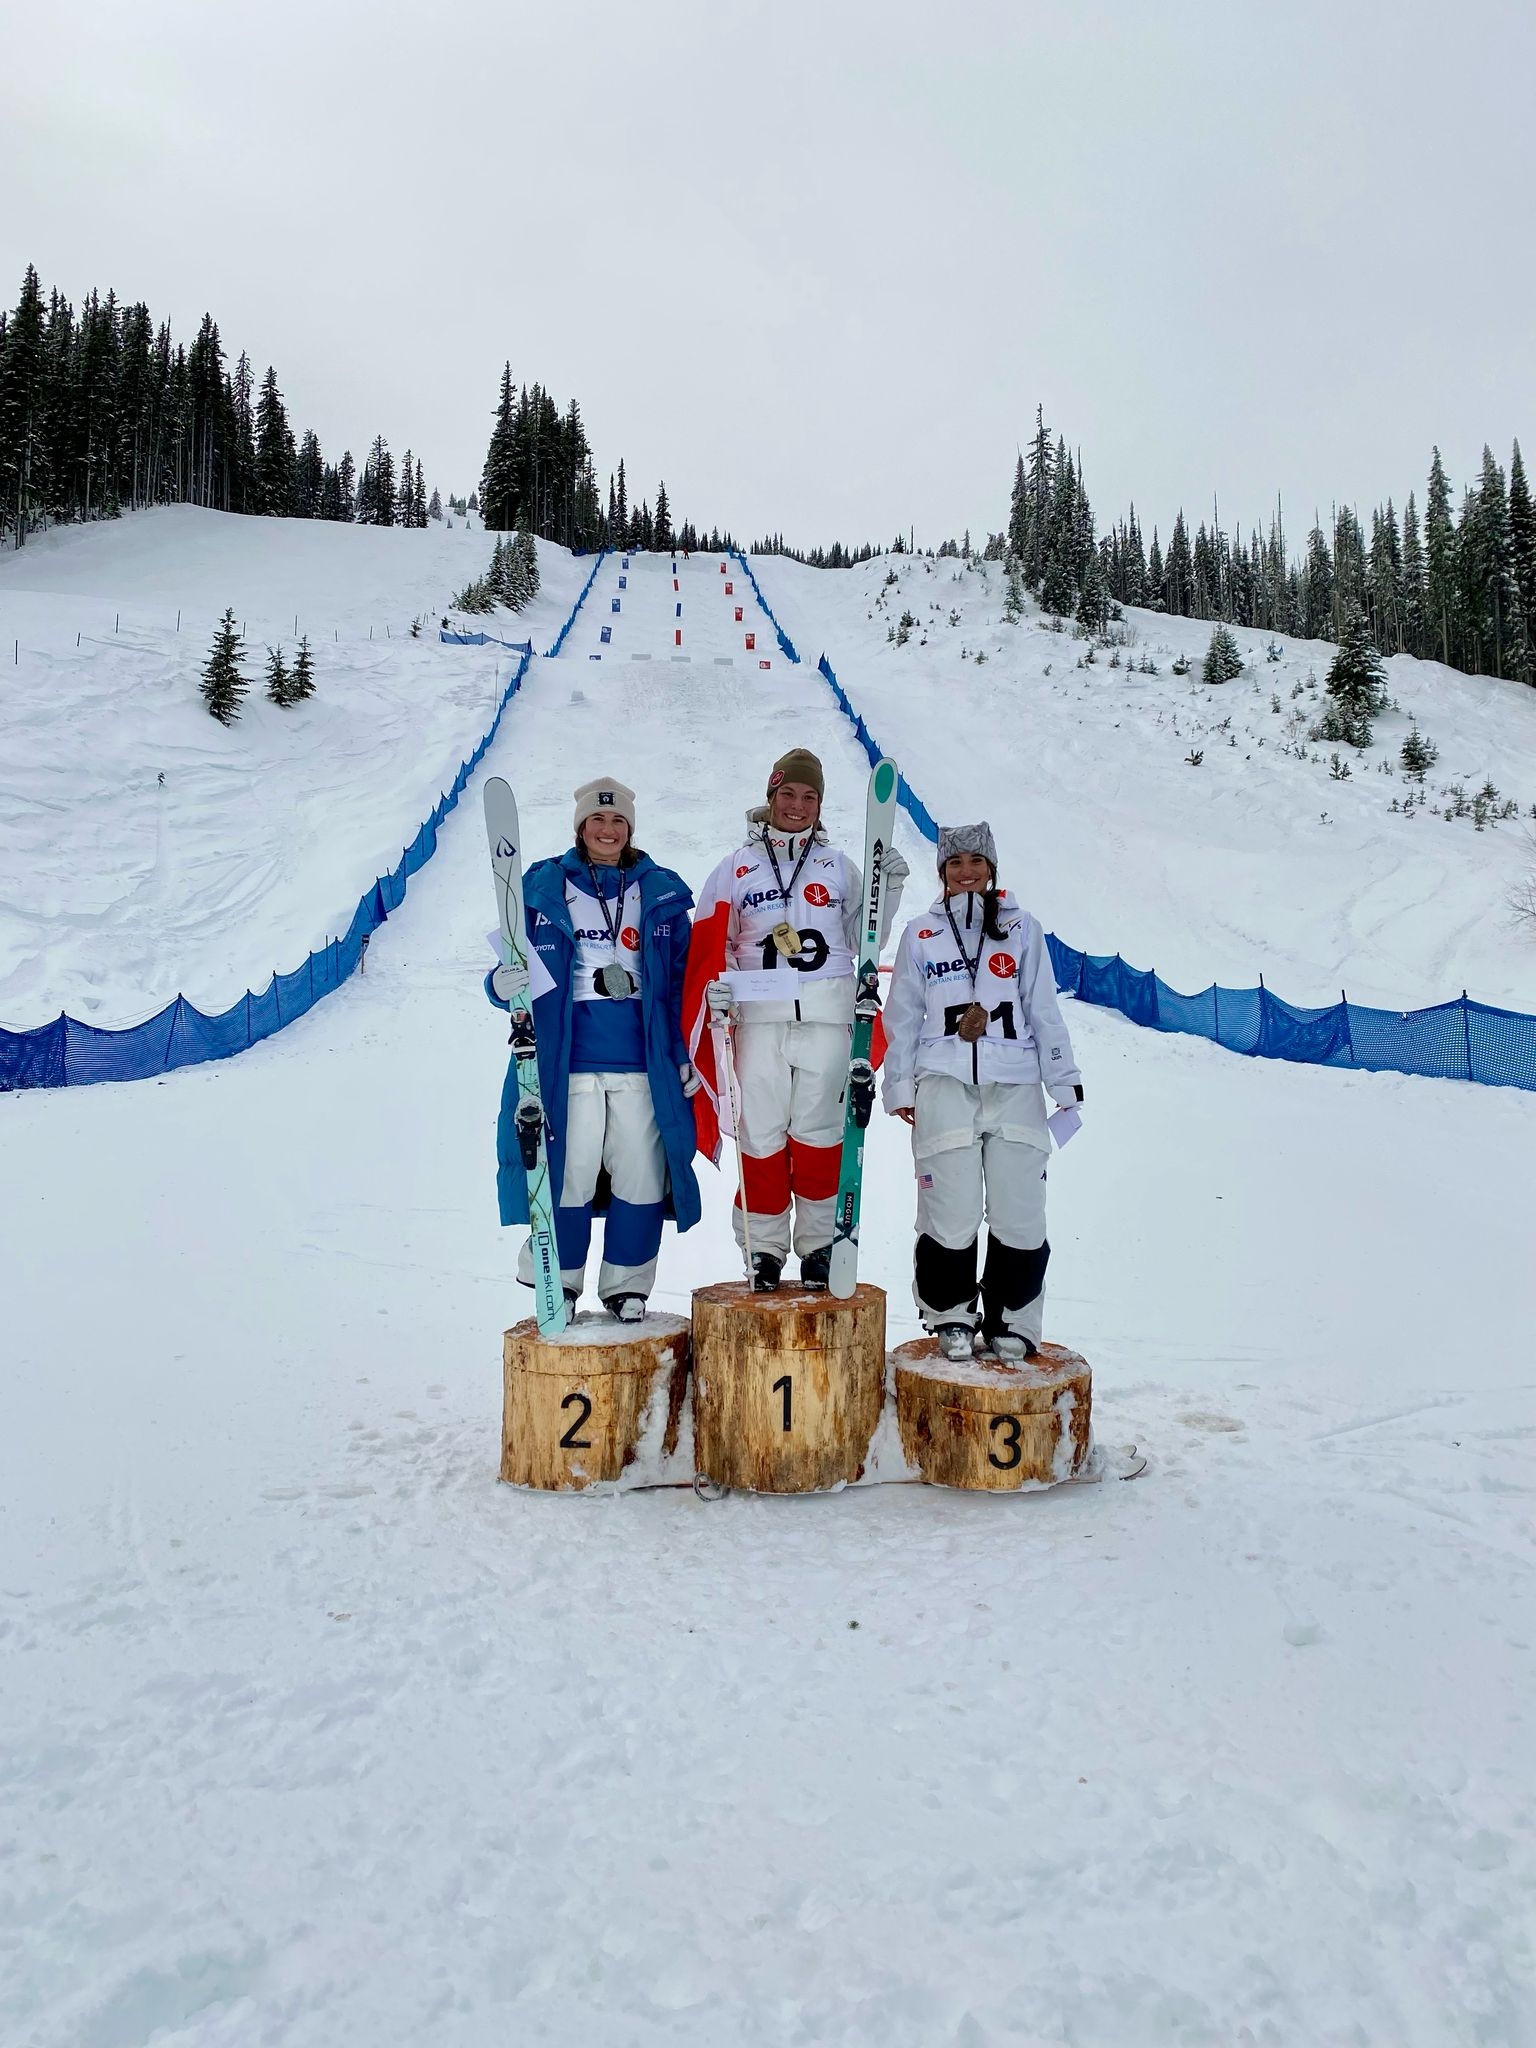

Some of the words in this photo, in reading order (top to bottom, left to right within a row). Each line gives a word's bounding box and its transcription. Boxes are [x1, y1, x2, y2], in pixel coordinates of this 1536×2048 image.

[767, 901, 793, 911] RESOT
[574, 928, 613, 942] pex
[533, 944, 556, 952] OYOTA
[953, 971, 972, 981] RESO
[772, 1375, 792, 1432] 1
[559, 1393, 592, 1449] 2
[988, 1414, 1022, 1471] 3
